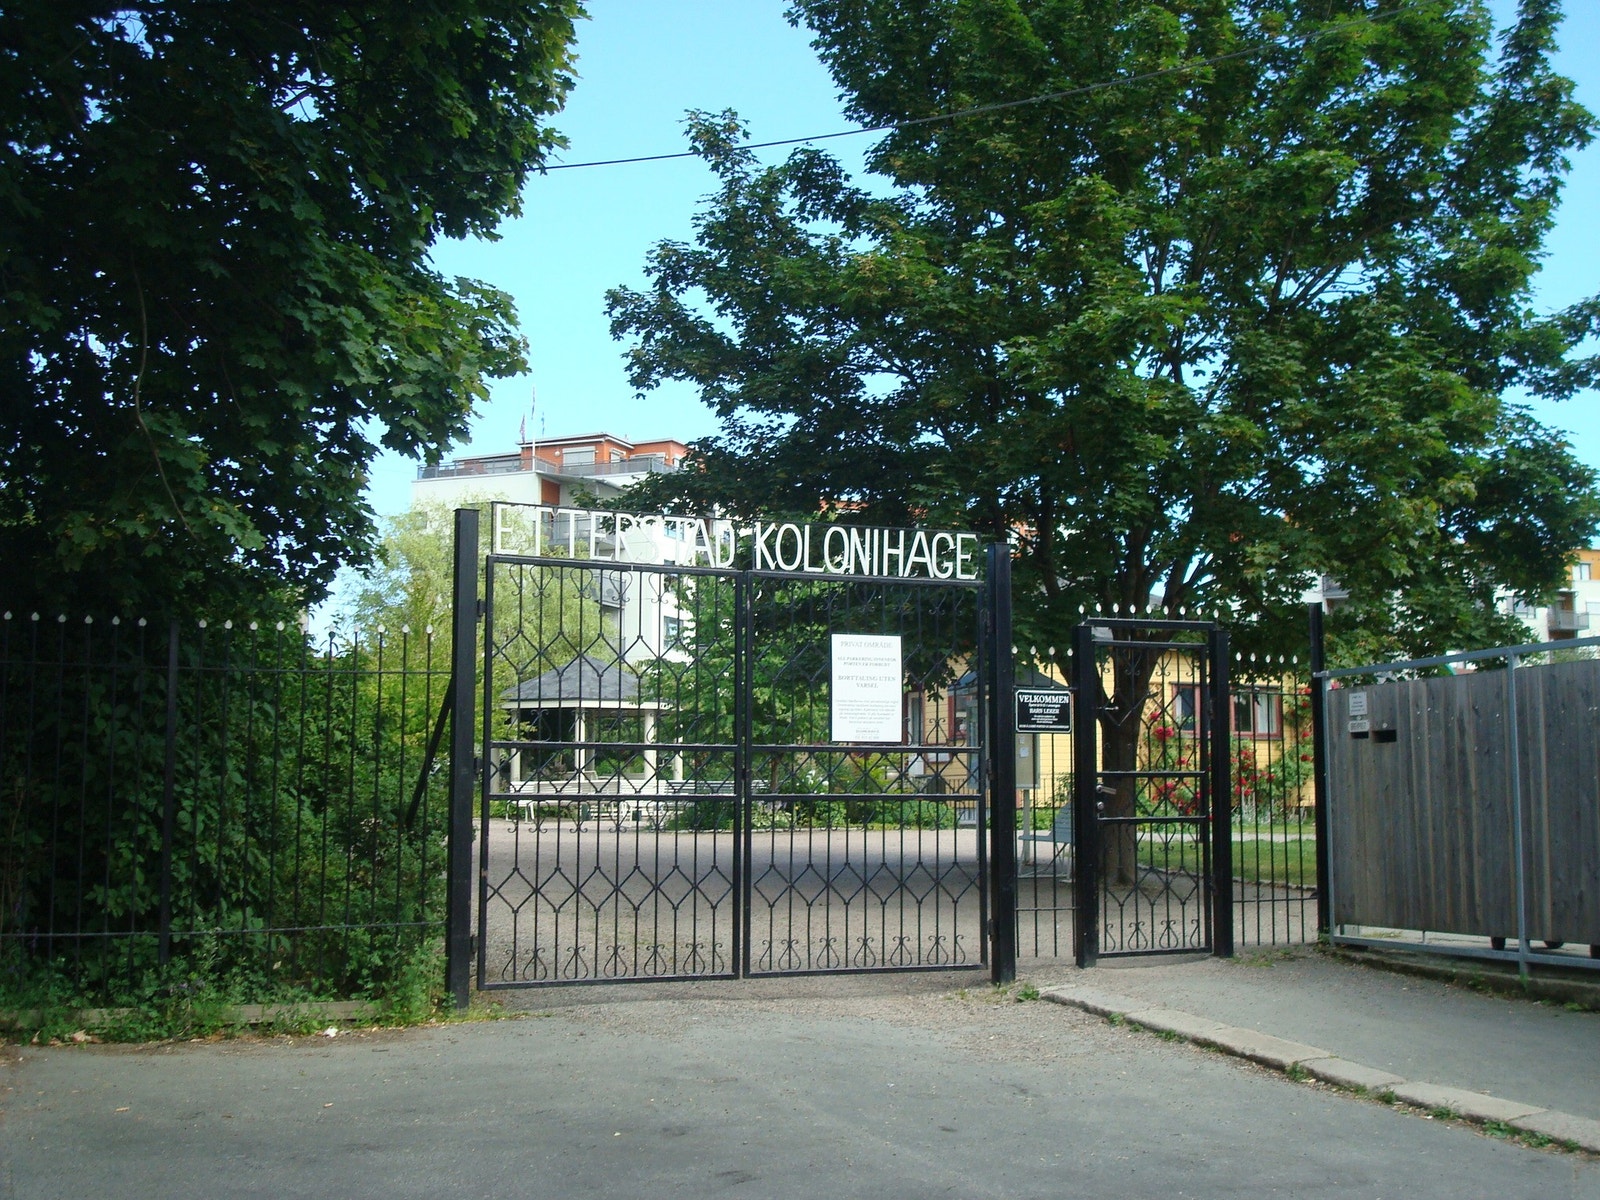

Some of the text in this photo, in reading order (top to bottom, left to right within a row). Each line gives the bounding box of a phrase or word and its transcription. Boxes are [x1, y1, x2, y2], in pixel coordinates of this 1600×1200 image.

[495, 504, 978, 580] ETTERSTAD KOLONIHAGE
[1019, 694, 1069, 704] VELKOMMEN
